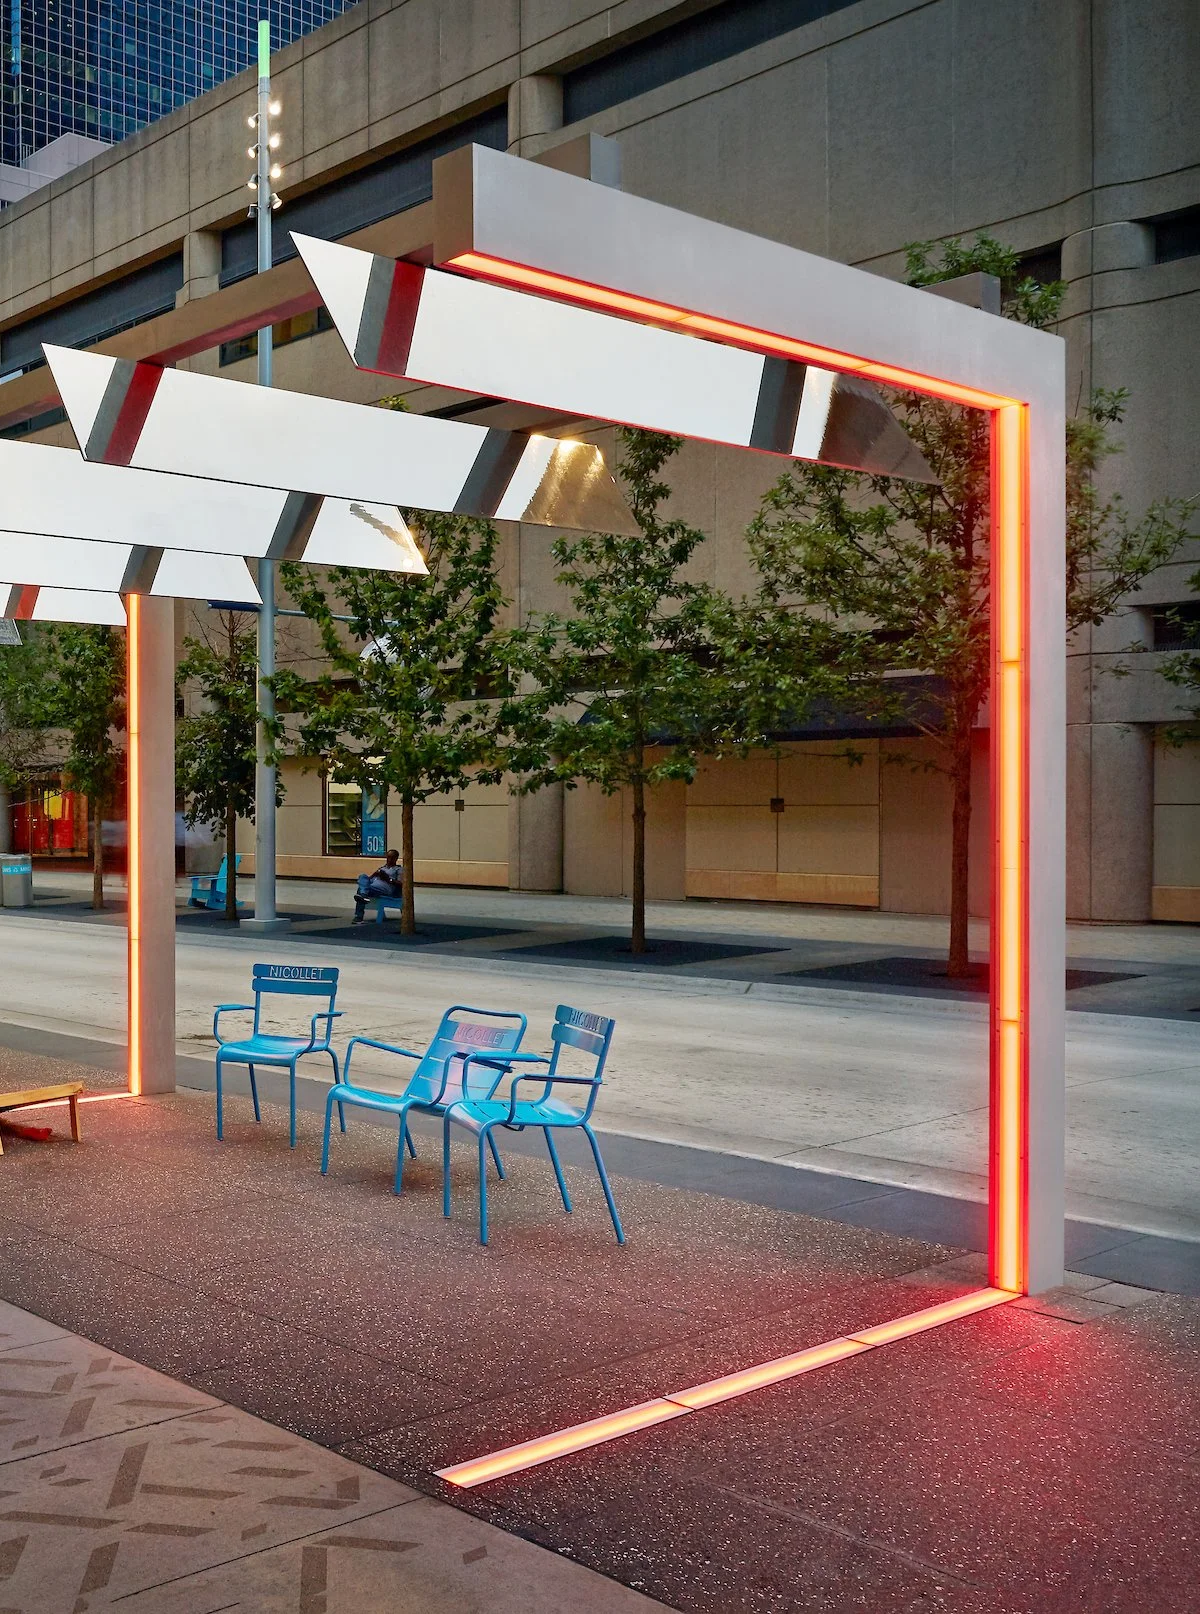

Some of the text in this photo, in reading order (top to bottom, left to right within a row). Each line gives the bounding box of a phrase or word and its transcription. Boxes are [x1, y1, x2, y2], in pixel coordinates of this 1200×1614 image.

[269, 966, 324, 980] NICOLLET
[569, 1009, 605, 1032] NICOLLET
[458, 1025, 508, 1046] NICOLLET
